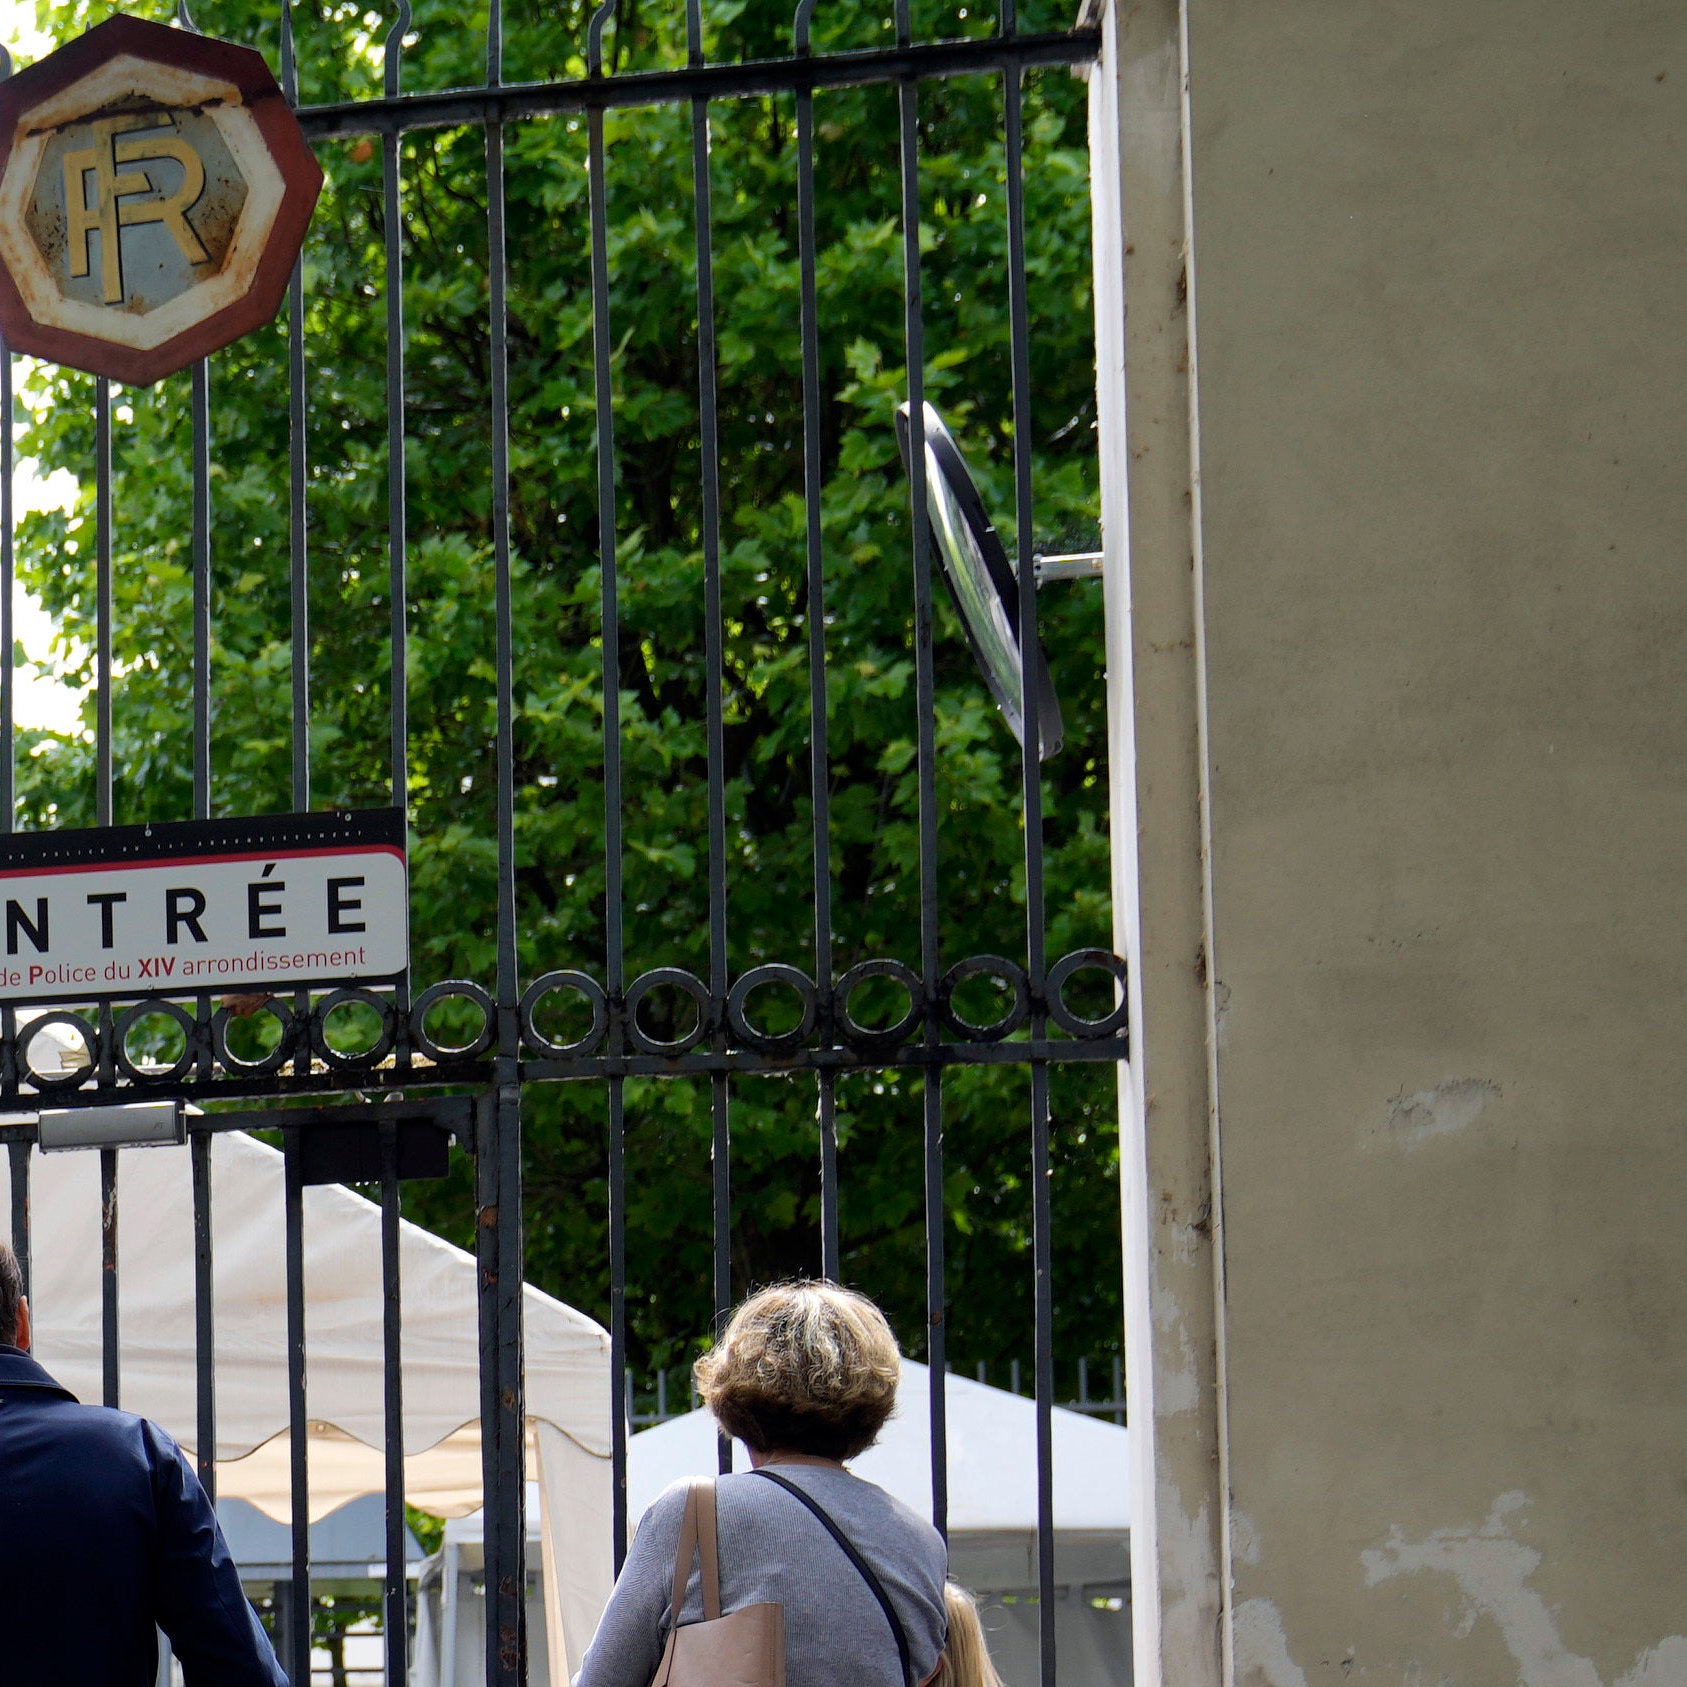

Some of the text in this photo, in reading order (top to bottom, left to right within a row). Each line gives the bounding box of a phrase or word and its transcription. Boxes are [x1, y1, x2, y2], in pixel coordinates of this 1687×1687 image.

[29, 961, 97, 986] Police
[103, 960, 131, 981] du
[137, 955, 176, 978] XIV
[182, 946, 367, 976] arrondissement
